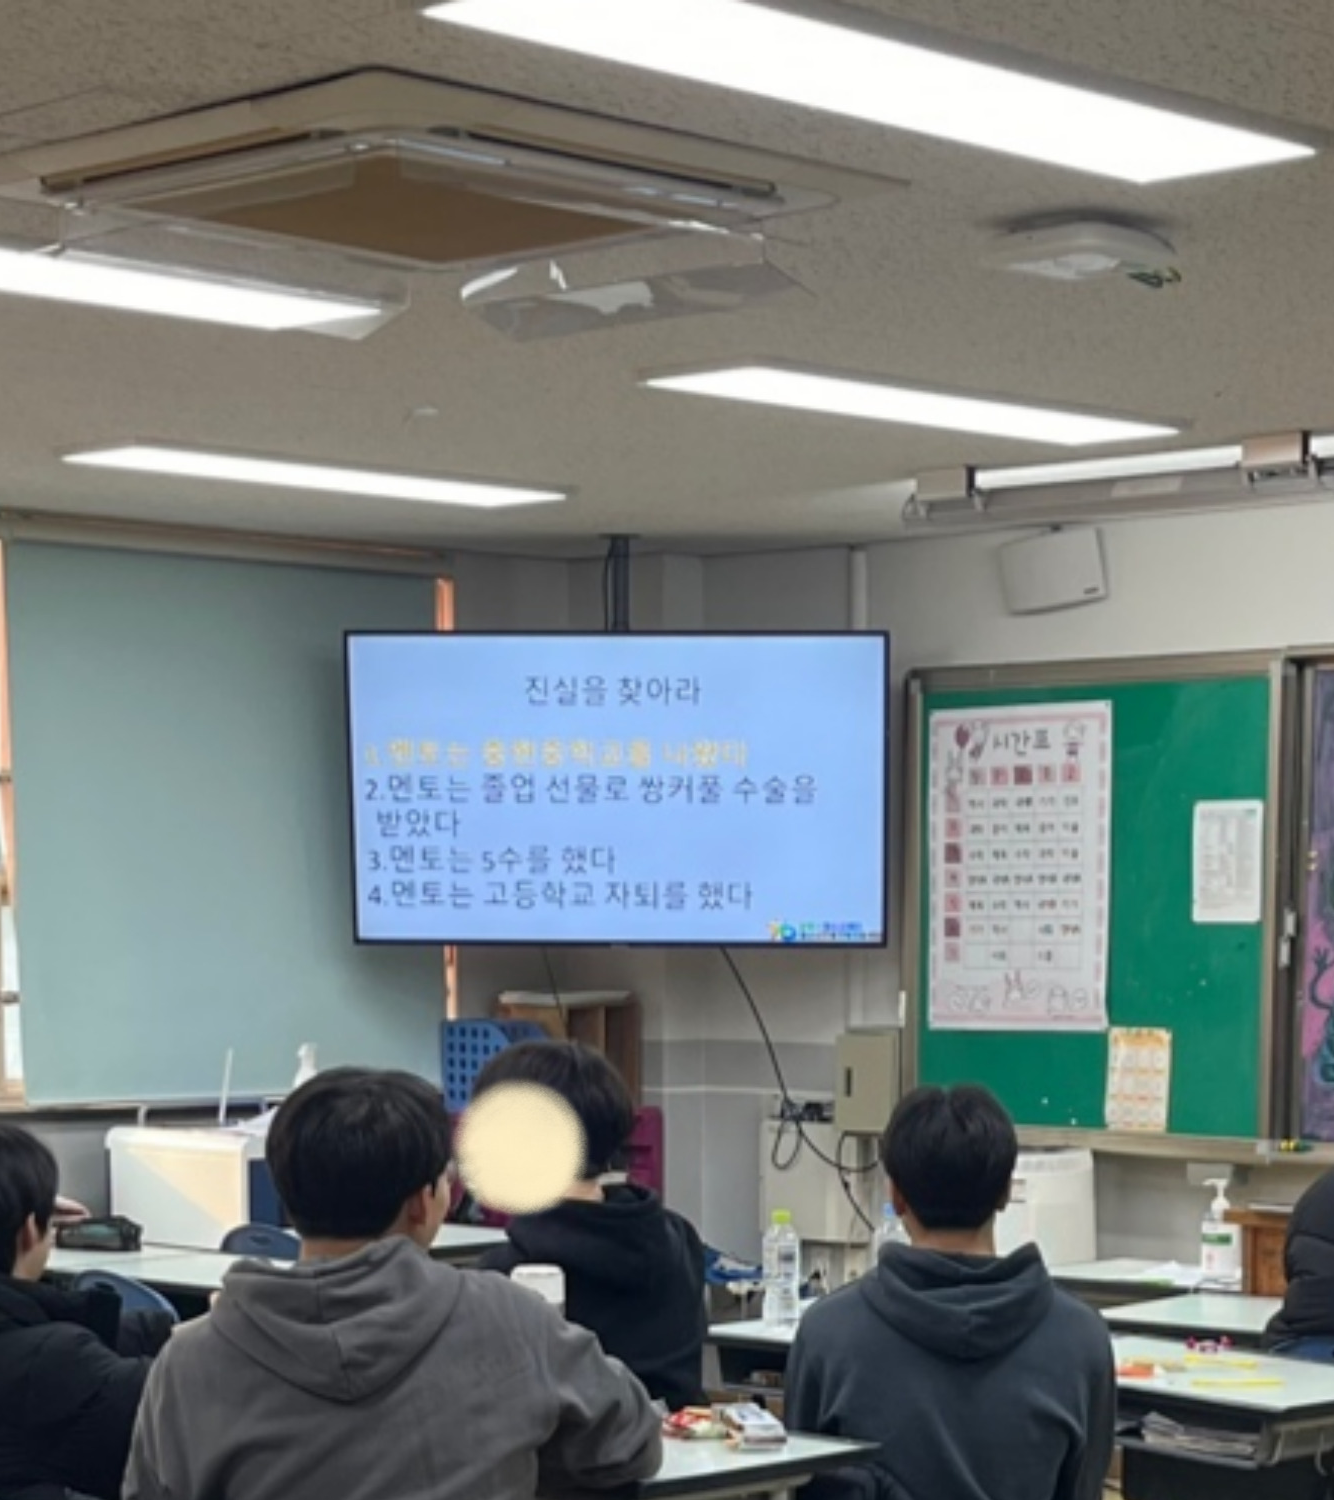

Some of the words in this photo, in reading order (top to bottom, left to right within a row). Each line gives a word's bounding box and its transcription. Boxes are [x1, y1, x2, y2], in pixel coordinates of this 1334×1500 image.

[525, 675, 608, 706] 진실을
[618, 675, 702, 706] 찾아라
[992, 728, 1053, 757] 시간표
[365, 774, 472, 806] 2.멘토는
[480, 773, 537, 805] 졸업
[546, 773, 629, 805] 선물로
[639, 773, 723, 805] 쌍커풀
[732, 772, 818, 805] 수술을
[377, 809, 461, 839] 받았다
[367, 845, 473, 875] 3.멘토는
[480, 845, 553, 875] 5수를
[562, 844, 616, 875] 했다
[367, 881, 474, 911] 4.멘토는
[482, 881, 595, 911] 고등학교
[604, 880, 689, 911] 자퇴를
[698, 880, 754, 911] 했다
